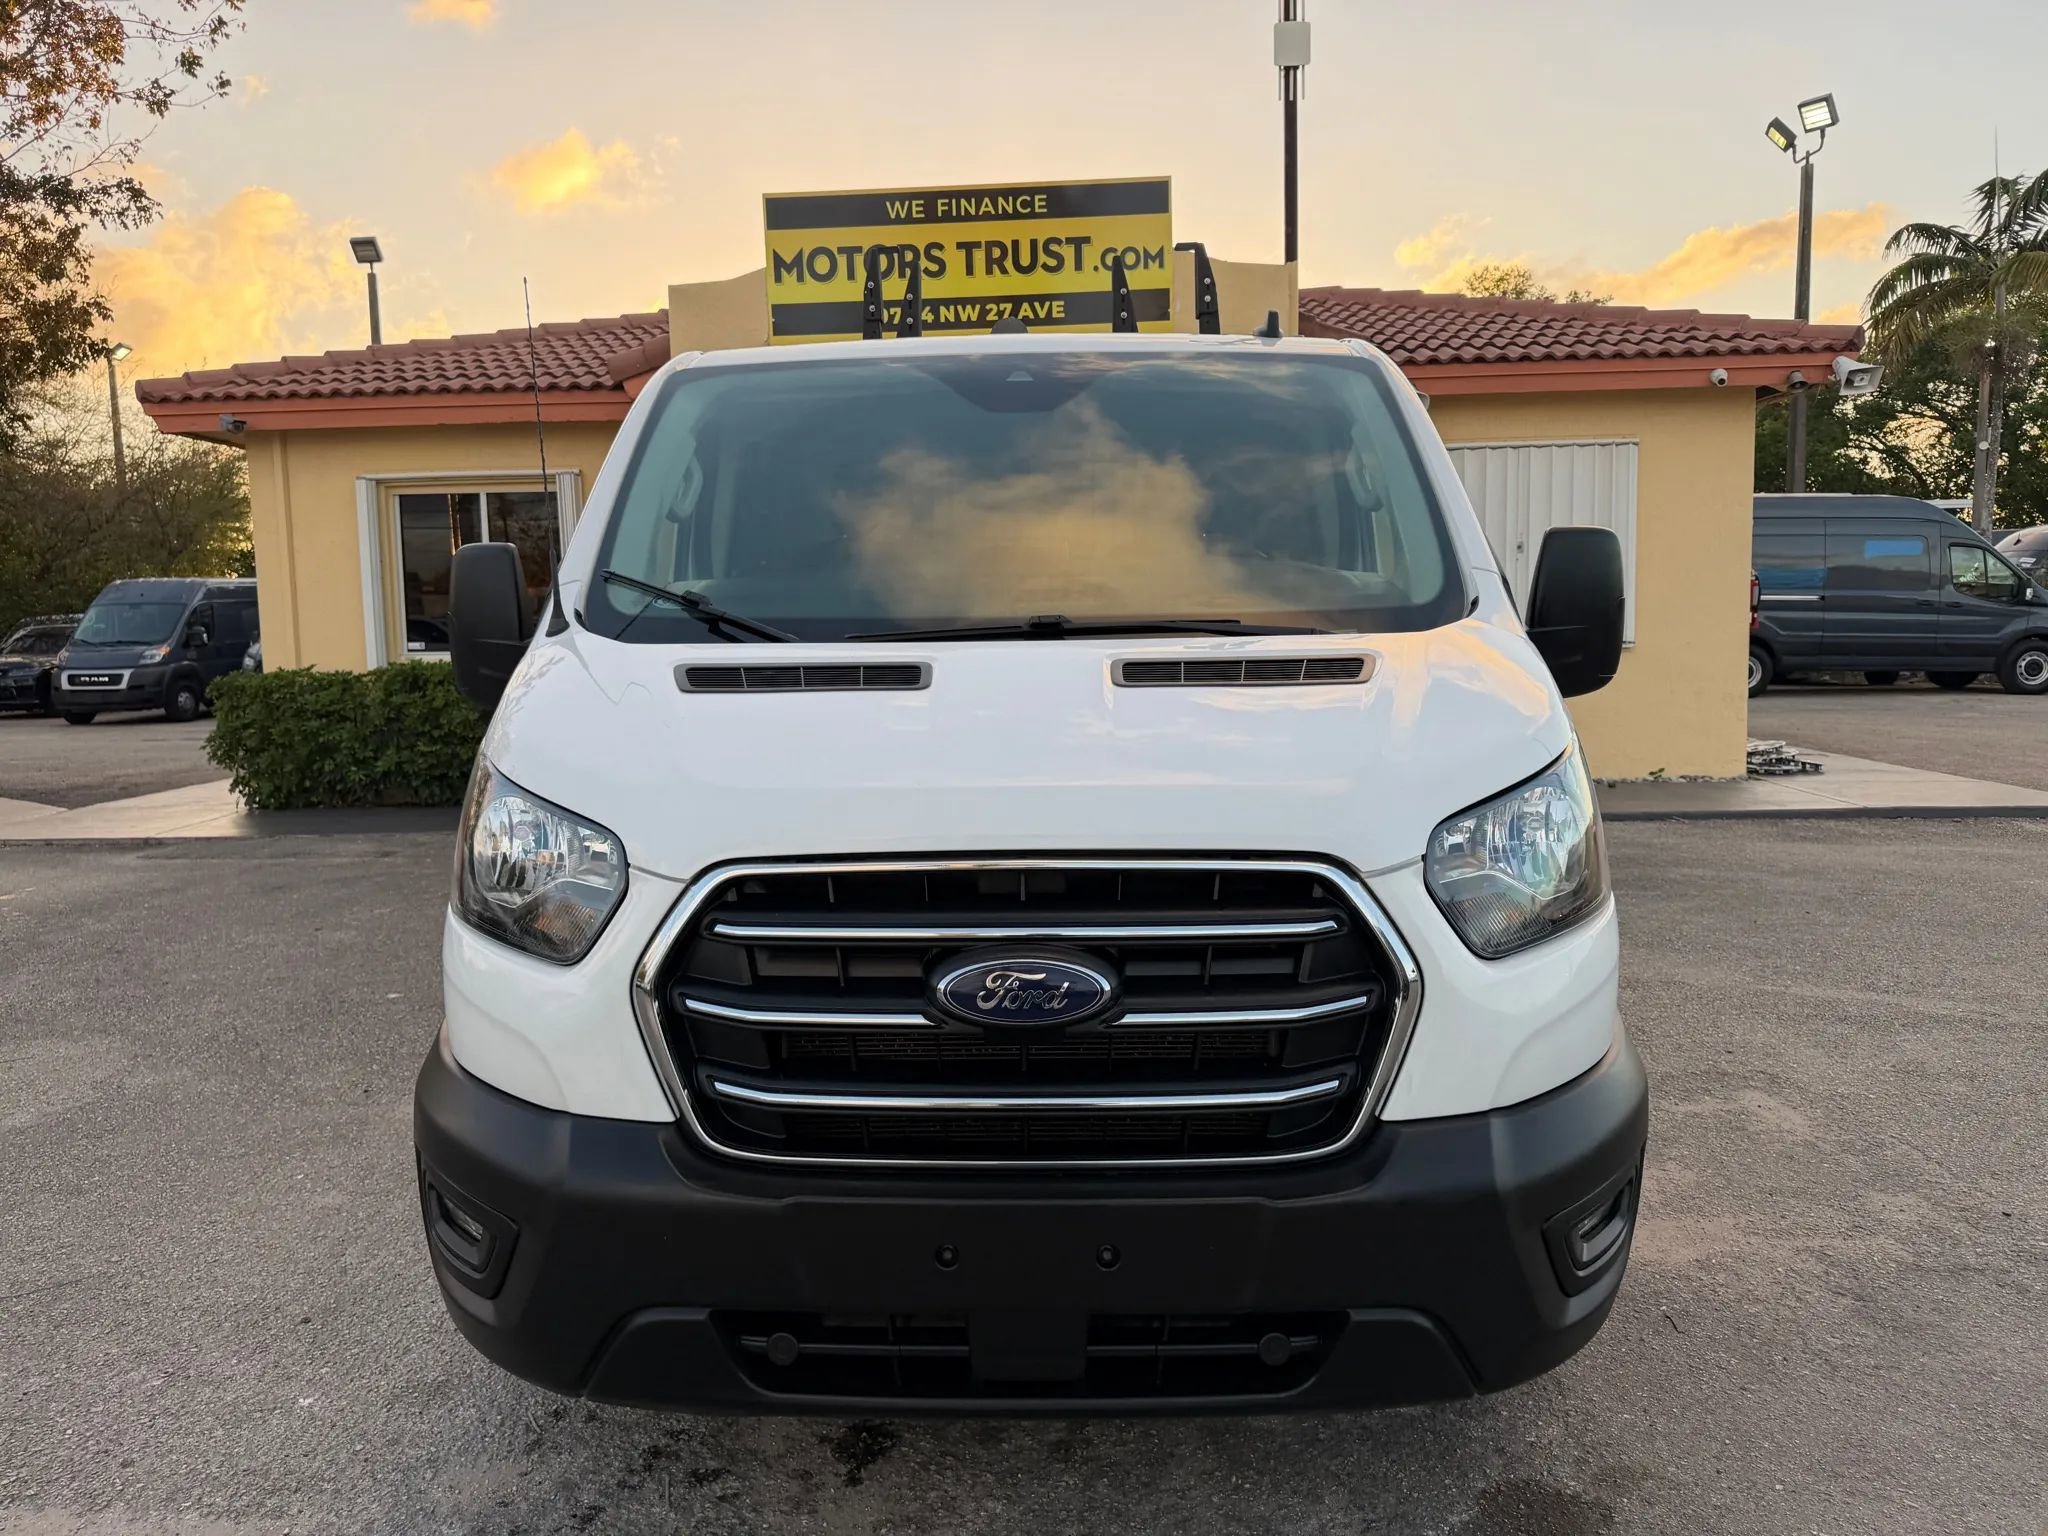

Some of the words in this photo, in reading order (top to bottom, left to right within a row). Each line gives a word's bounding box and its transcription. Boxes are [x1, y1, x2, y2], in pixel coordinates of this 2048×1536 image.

[886, 200, 925, 219] WE
[937, 194, 1048, 217] FINANCE
[772, 241, 948, 285] MOTORS
[940, 304, 981, 323] NW
[985, 303, 1013, 321] 27
[1017, 301, 1065, 319] AVE
[976, 971, 1069, 1010] Ford
